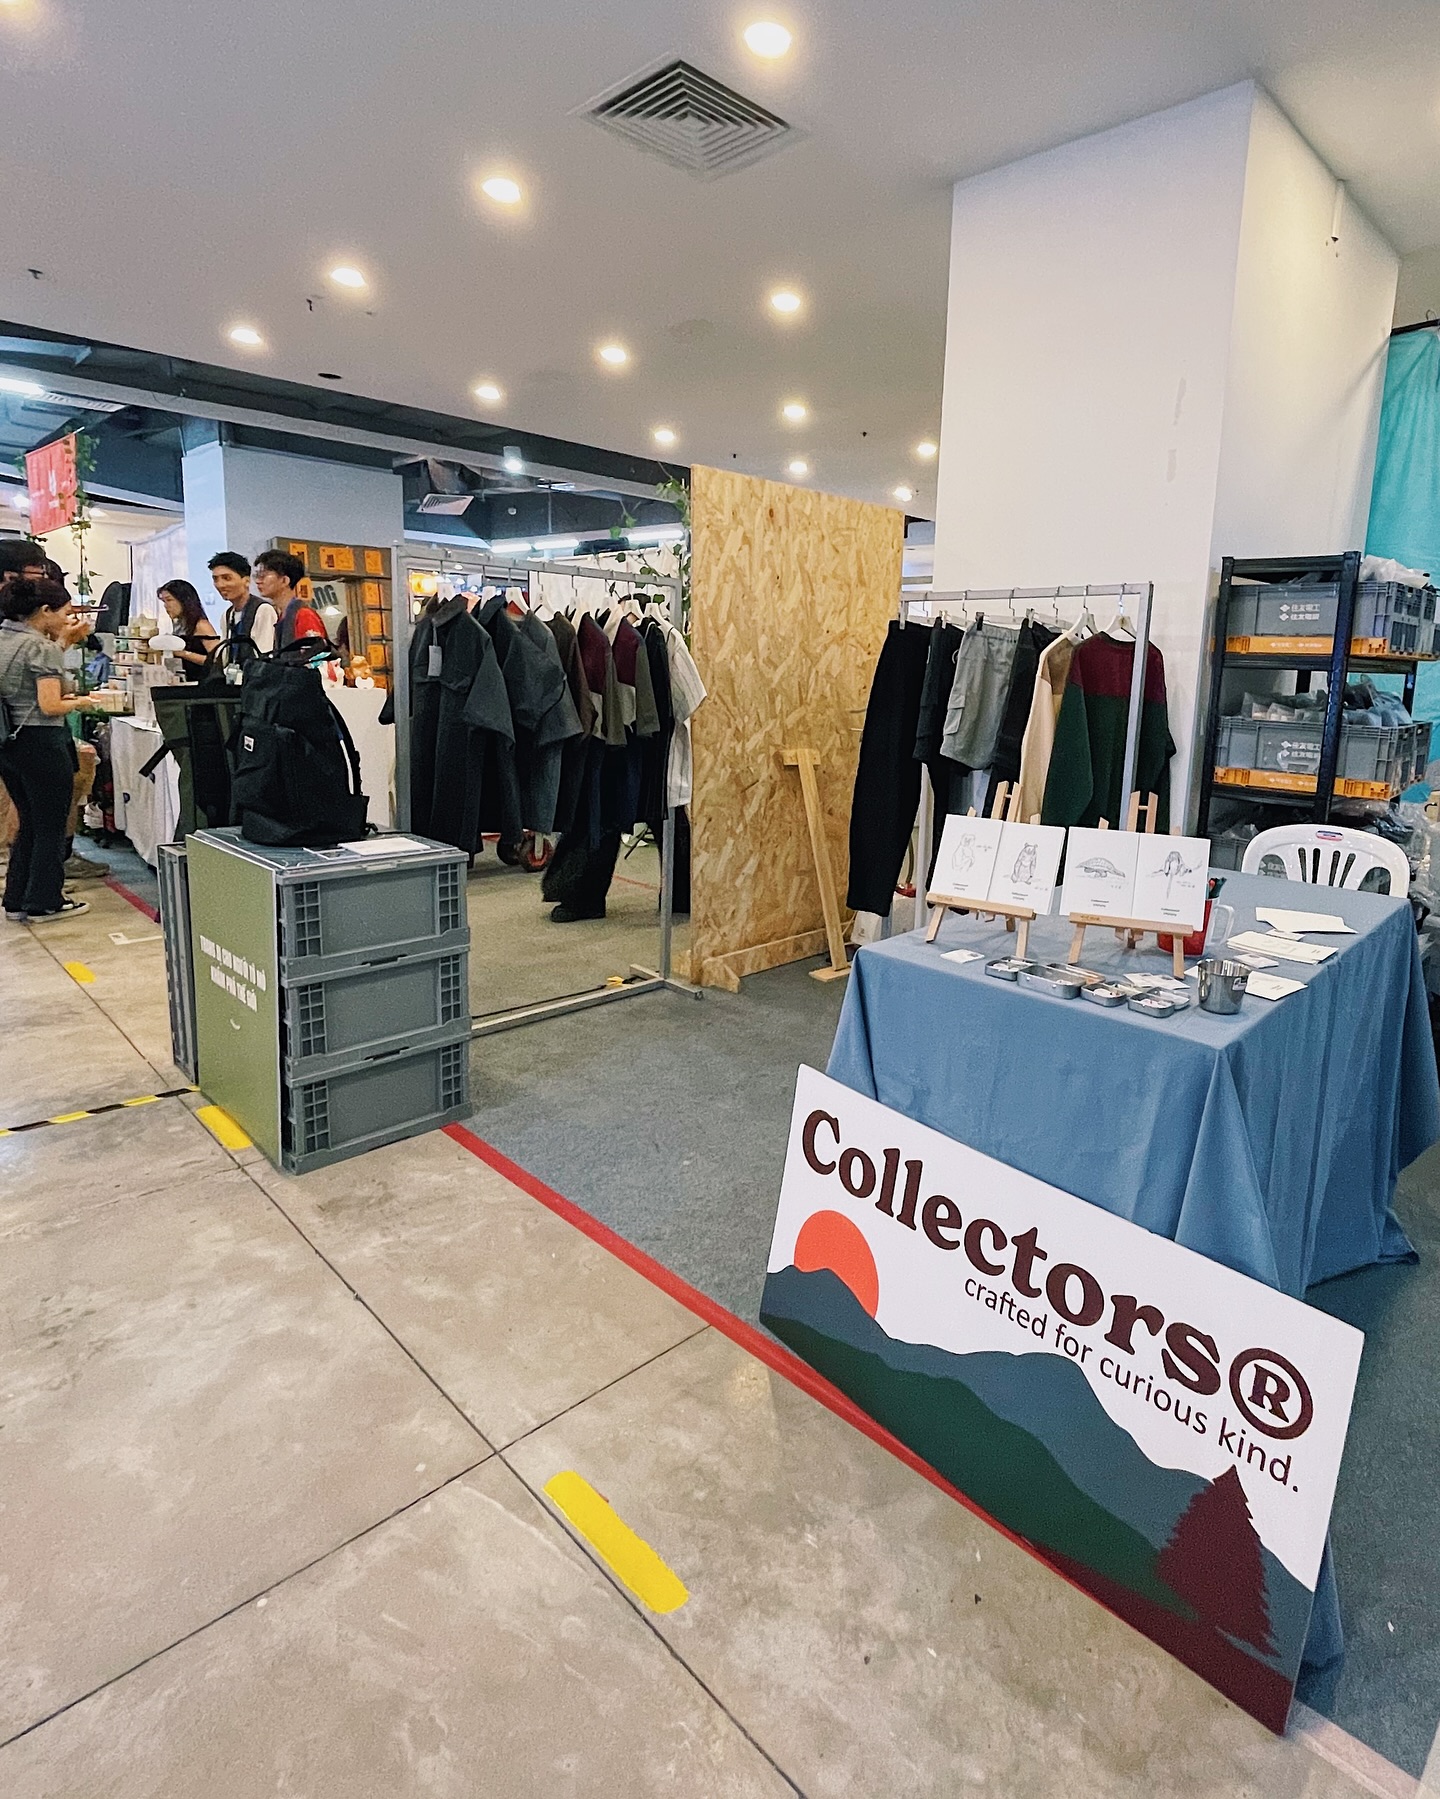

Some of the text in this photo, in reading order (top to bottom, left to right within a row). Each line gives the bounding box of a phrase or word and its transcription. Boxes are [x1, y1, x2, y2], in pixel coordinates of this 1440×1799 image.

[964, 1277, 1299, 1493] crafted for curious kind.
